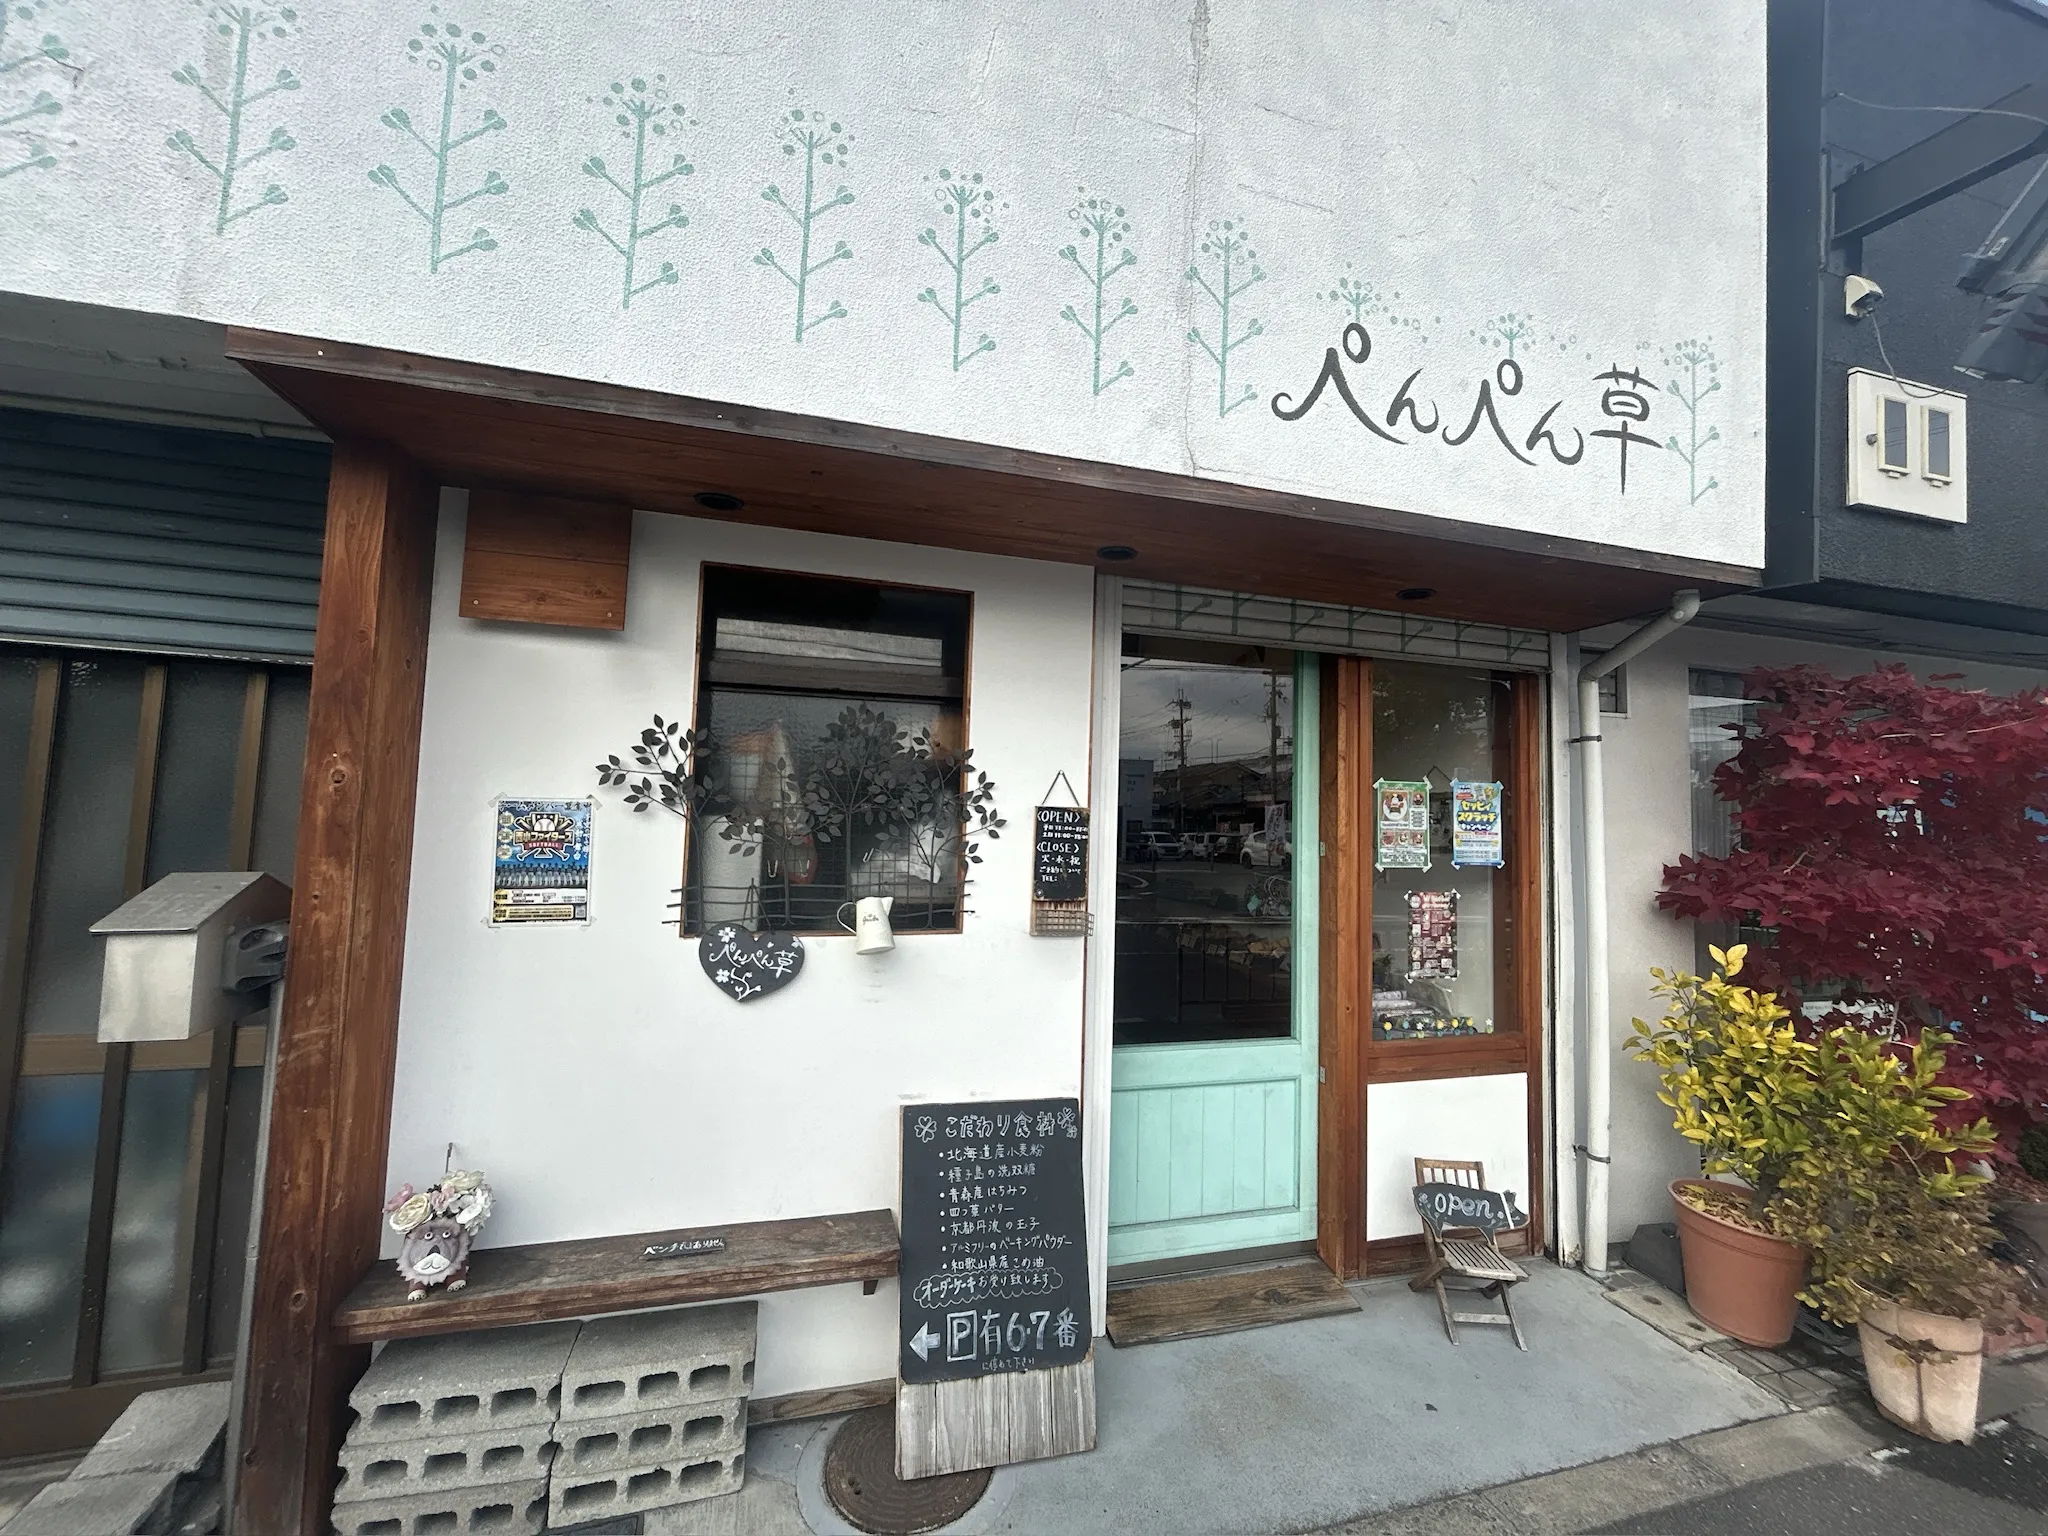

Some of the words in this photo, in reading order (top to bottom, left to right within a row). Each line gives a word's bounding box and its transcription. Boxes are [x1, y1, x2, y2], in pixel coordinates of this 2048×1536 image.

[1271, 322, 1663, 496] ぺんぺん草
[1457, 812, 1496, 822] スクラッチ
[709, 941, 799, 979] ぺんぺん草
[947, 1143, 1045, 1162] 北海道産小麦粉
[947, 1162, 1036, 1184] 種子島の洗双糖
[950, 1217, 1040, 1237] 京都丹波の玉子
[951, 1255, 1045, 1273] 和歌山県産こめ油
